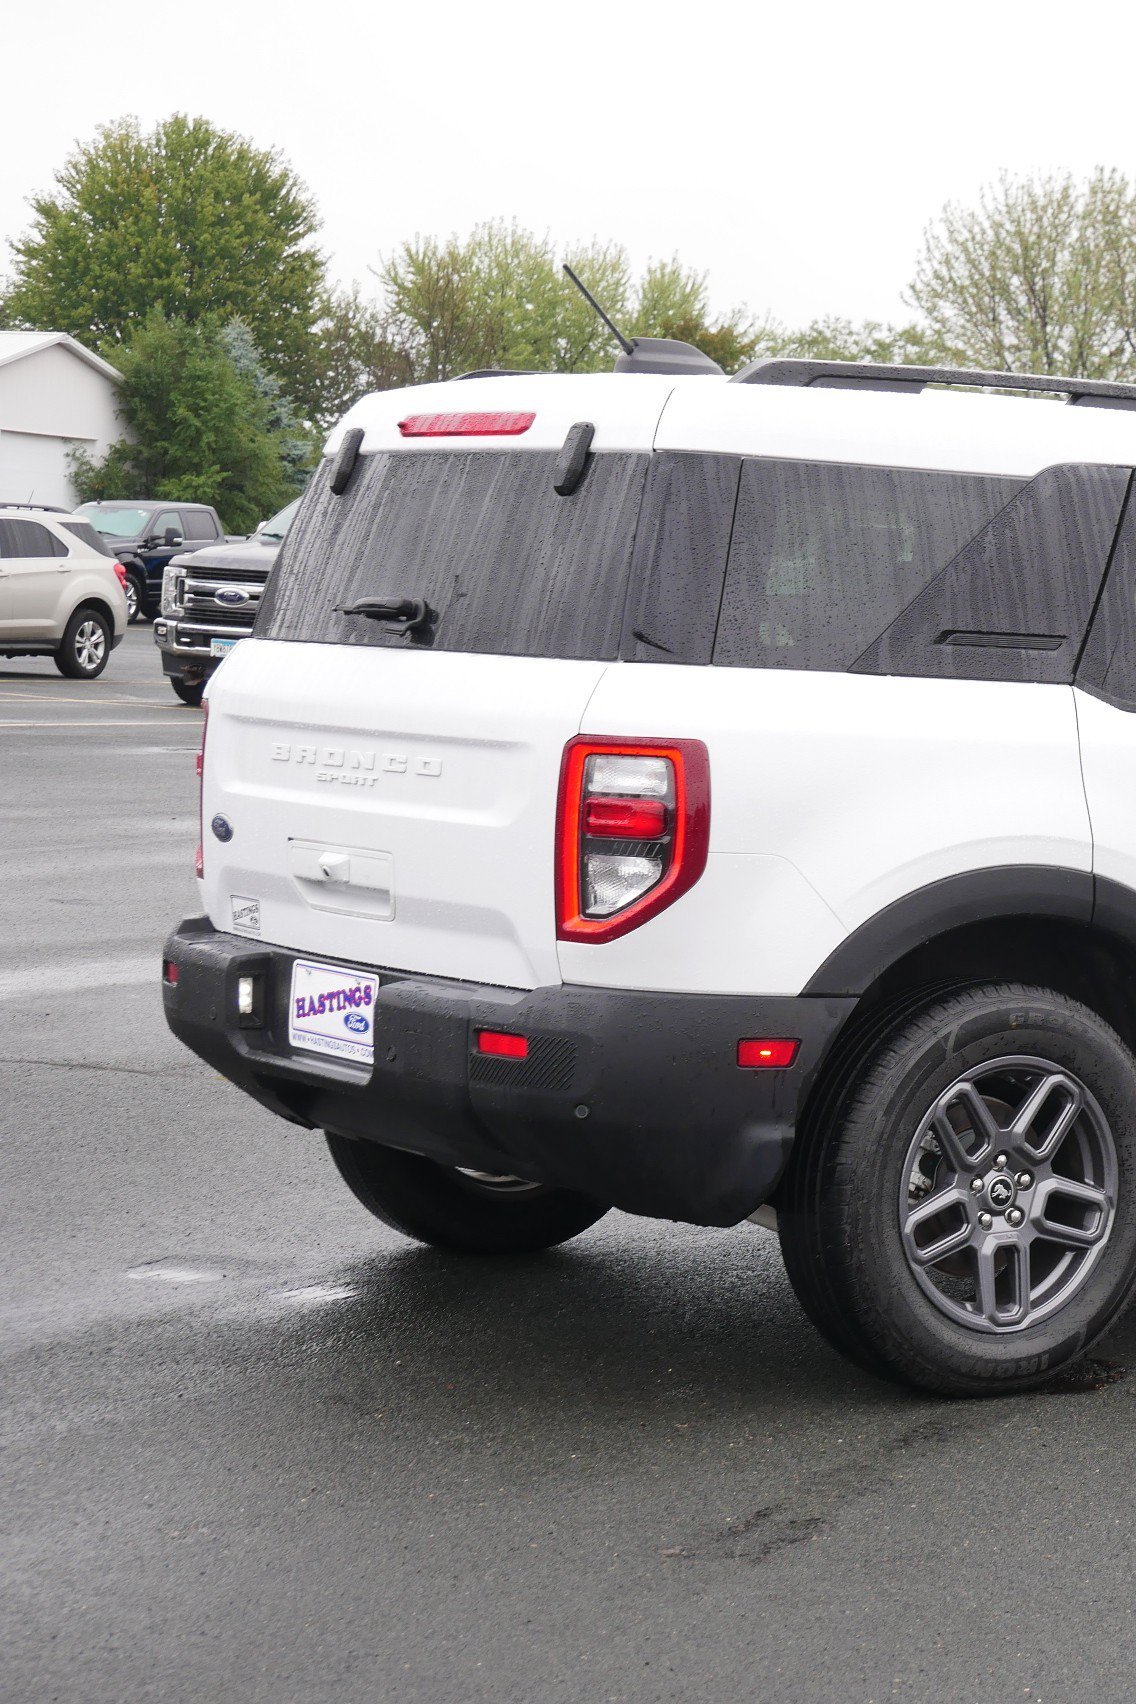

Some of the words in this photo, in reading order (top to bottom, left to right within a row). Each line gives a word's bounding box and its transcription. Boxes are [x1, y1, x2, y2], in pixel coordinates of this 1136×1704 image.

[271, 743, 443, 777] BRONCO
[315, 771, 380, 786] SPORT
[295, 985, 372, 1018] HASTINGS
[346, 1014, 367, 1031] Ford
